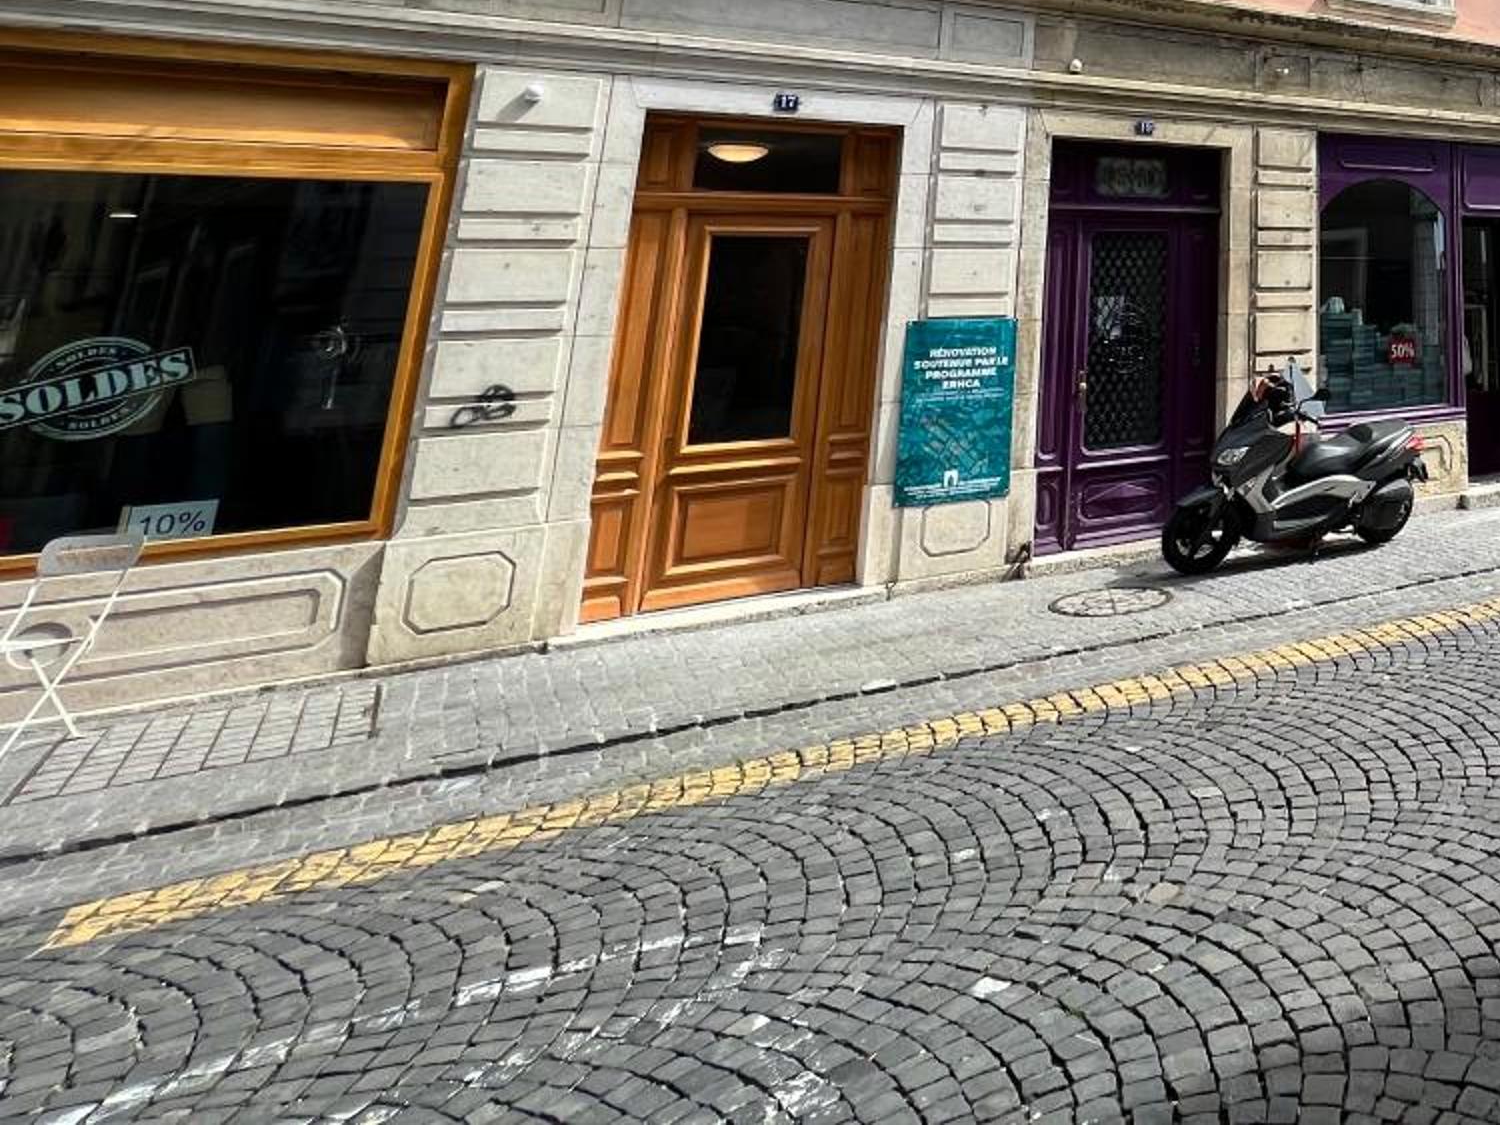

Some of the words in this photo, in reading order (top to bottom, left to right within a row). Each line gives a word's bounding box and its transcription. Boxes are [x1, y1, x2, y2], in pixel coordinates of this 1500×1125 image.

[781, 95, 797, 108] 17
[929, 346, 997, 358] RÉNOVATION
[1391, 342, 1415, 359] 50%
[925, 366, 997, 380] PROGRAMME
[0, 352, 190, 422] SOLDES
[139, 509, 206, 537] 10%
